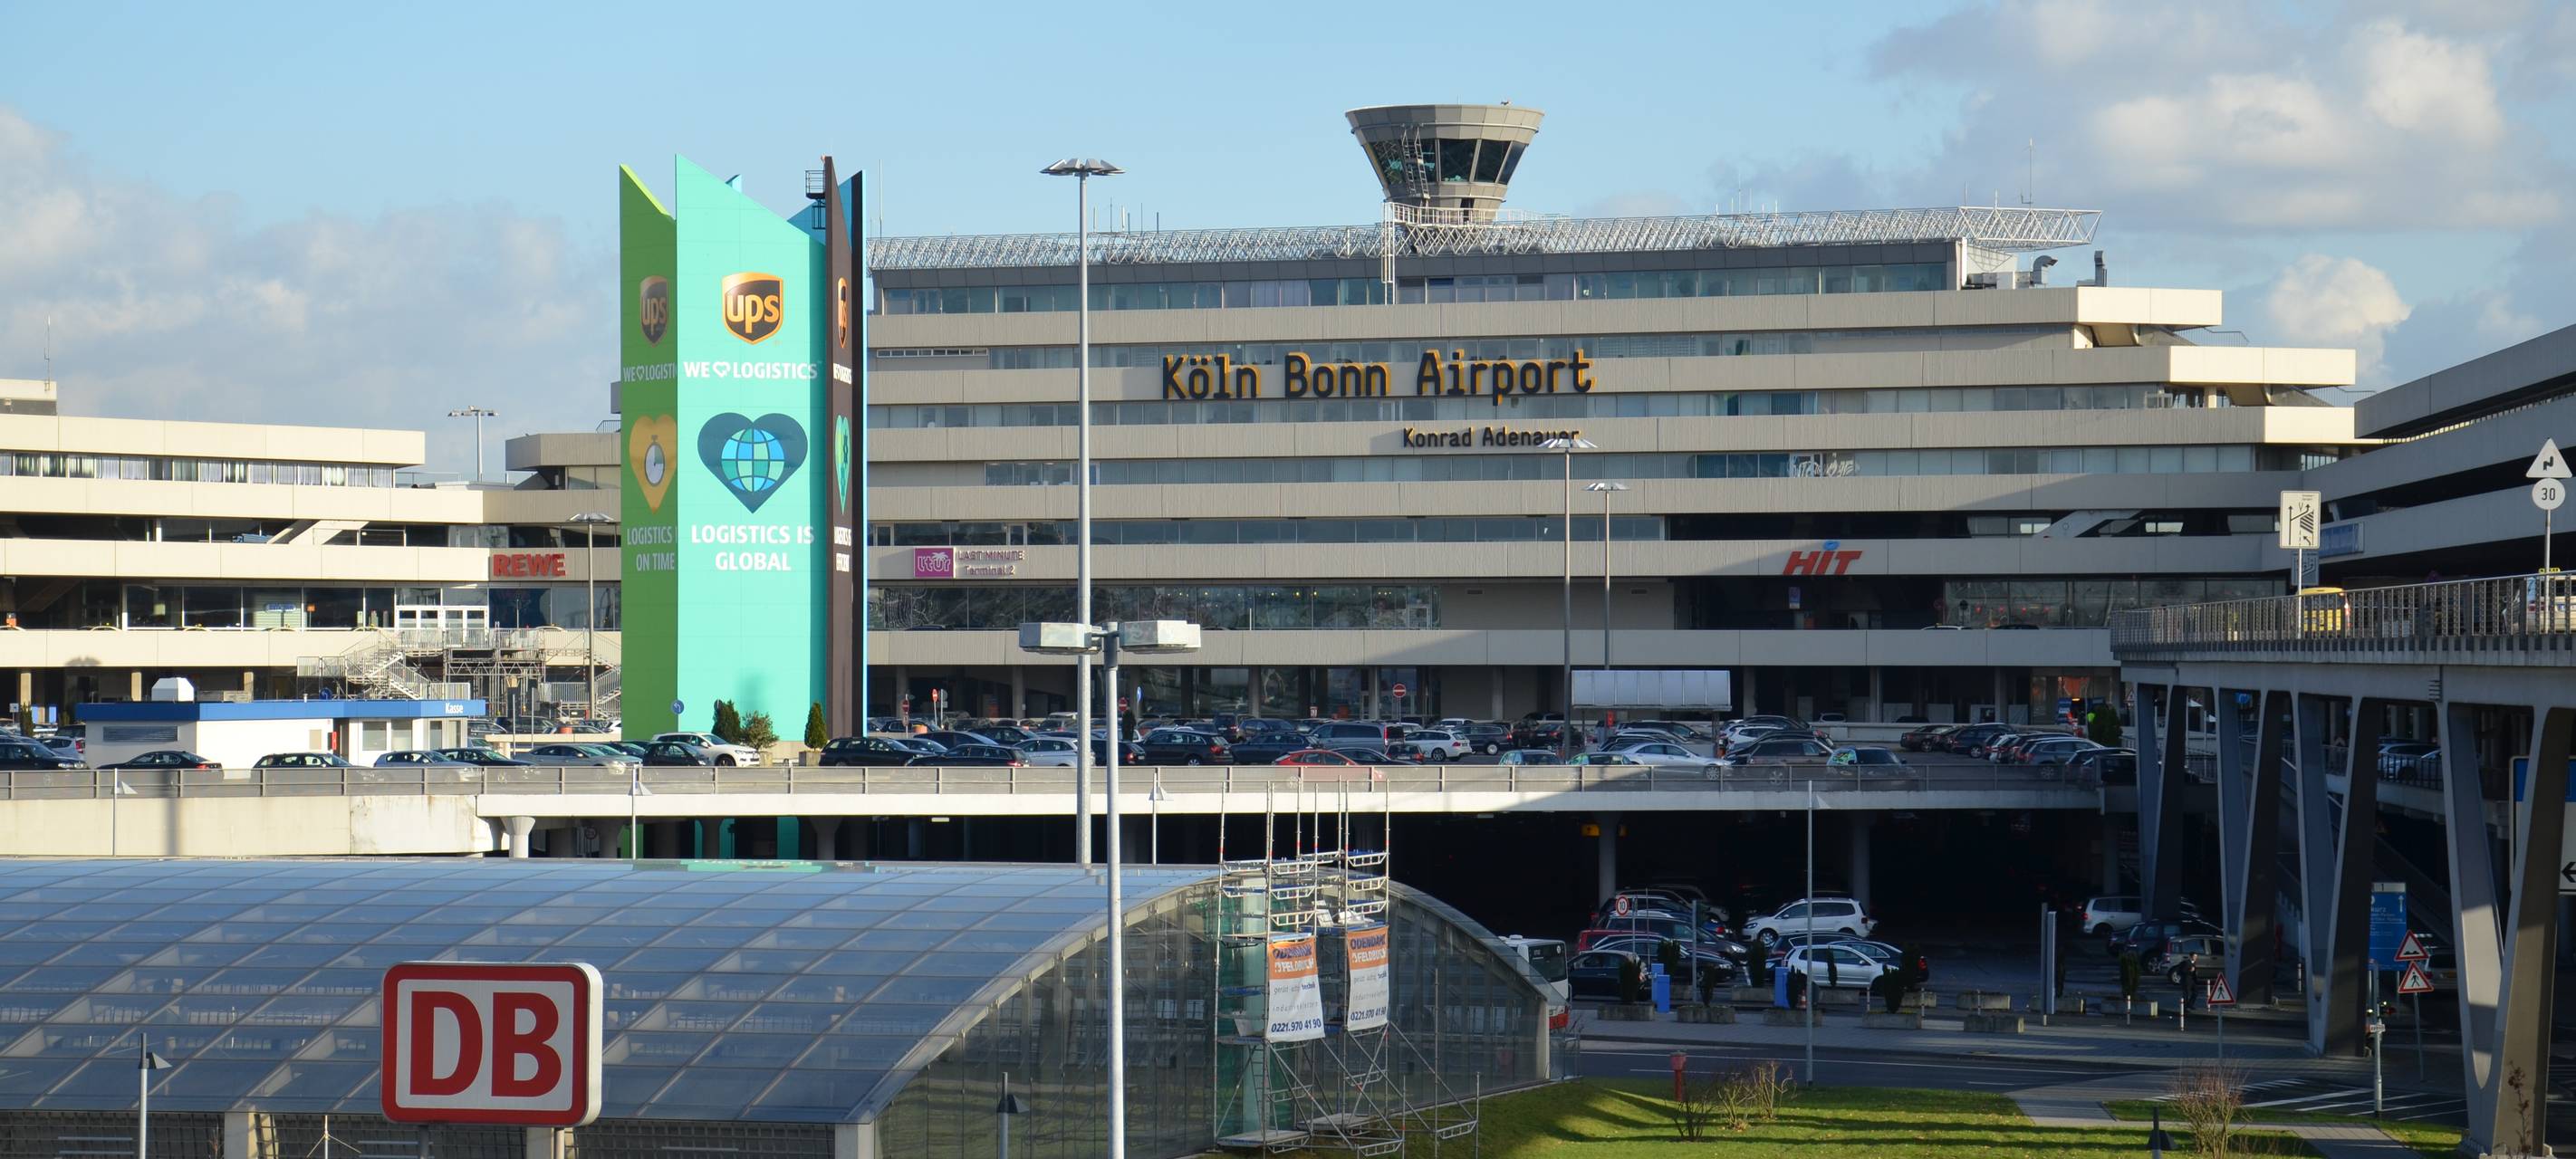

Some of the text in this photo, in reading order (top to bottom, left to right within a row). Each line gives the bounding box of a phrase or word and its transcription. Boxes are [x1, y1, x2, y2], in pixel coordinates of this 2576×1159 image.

[641, 297, 667, 335] ups
[726, 294, 780, 334] ups
[623, 367, 636, 382] WE
[683, 361, 711, 378] WE
[733, 361, 818, 379] LOGISTICS
[1162, 350, 1595, 406] Köln Bonn Airport
[1404, 427, 1474, 447] Konrad
[2541, 488, 2556, 501] 30
[627, 526, 673, 545] LOGISTICS
[691, 525, 791, 544] LOGISTICS
[797, 525, 815, 544] IS
[637, 552, 675, 570] ON TIME
[716, 552, 792, 571] GLOBAL
[958, 550, 1024, 560] LAST MINUTE
[493, 553, 566, 577] REWE
[966, 565, 1015, 576] Terminal 2
[446, 702, 464, 714] Kasse
[1271, 1020, 1303, 1032] 0221.970
[409, 991, 562, 1097] DB
